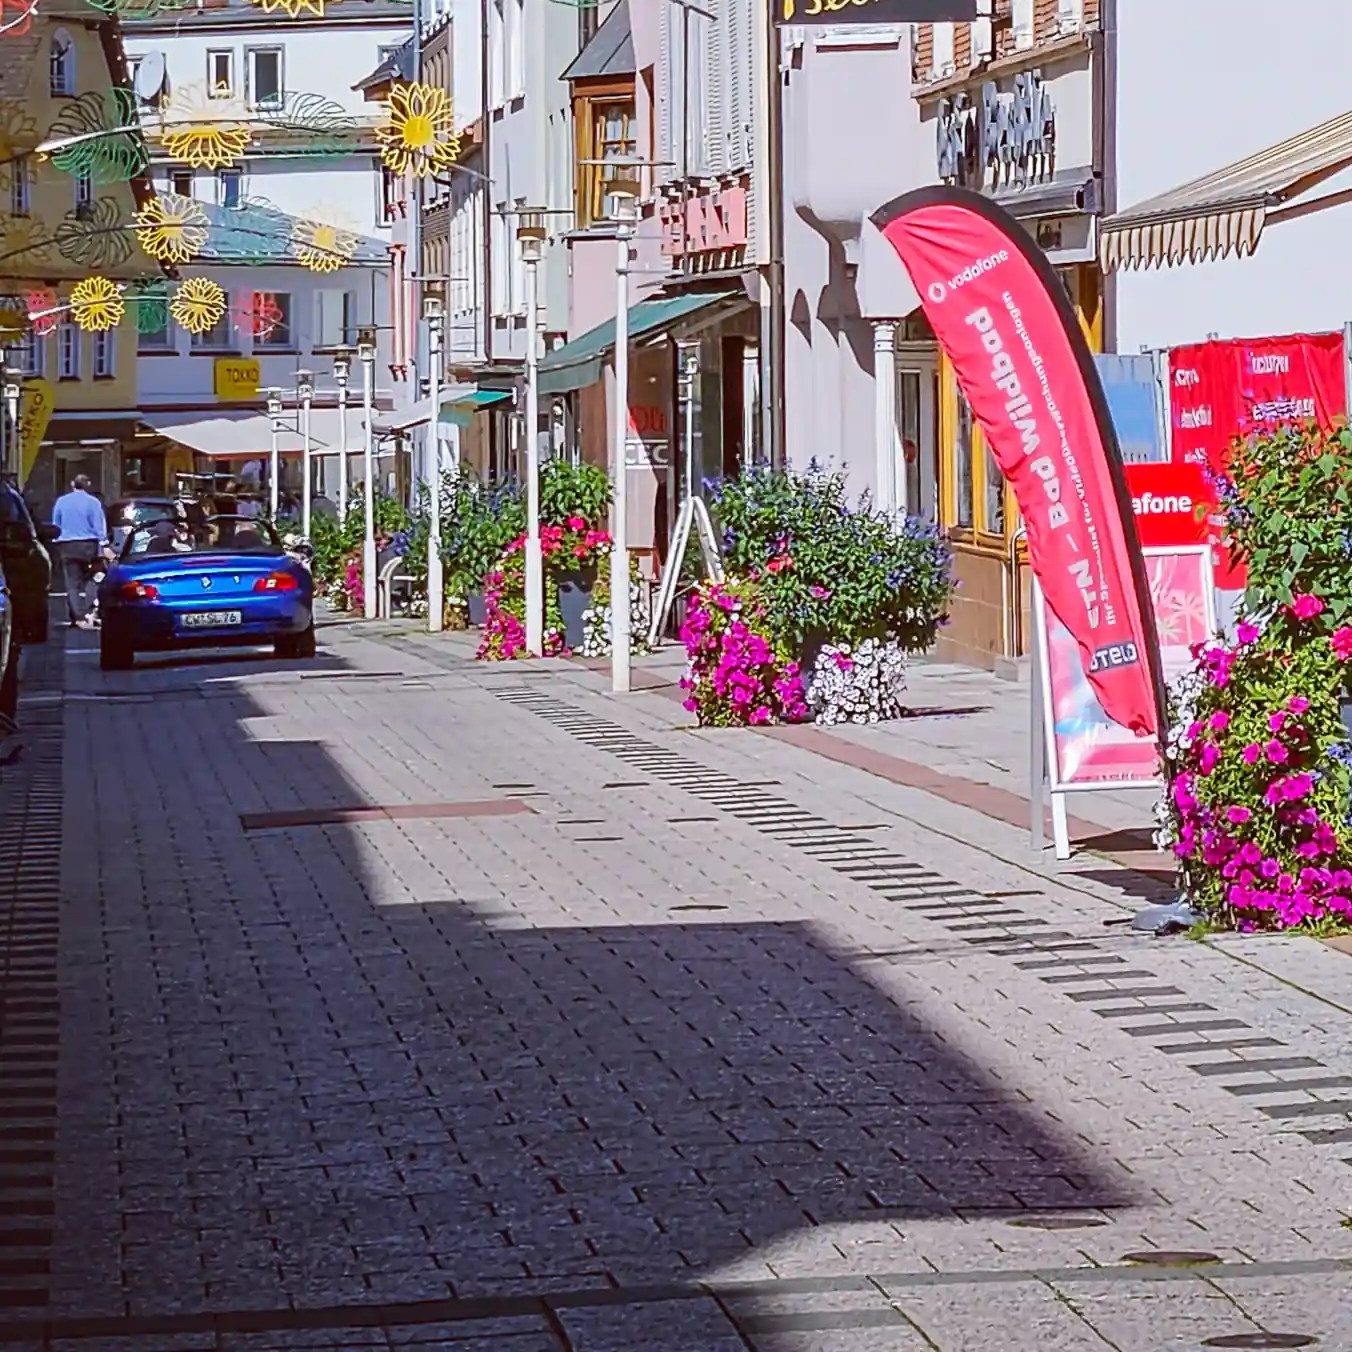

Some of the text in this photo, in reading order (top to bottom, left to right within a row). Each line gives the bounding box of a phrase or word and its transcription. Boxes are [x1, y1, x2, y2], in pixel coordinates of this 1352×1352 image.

[947, 249, 1010, 291] vodafone
[965, 305, 1041, 456] Wildbad
[1030, 454, 1070, 530] Bad
